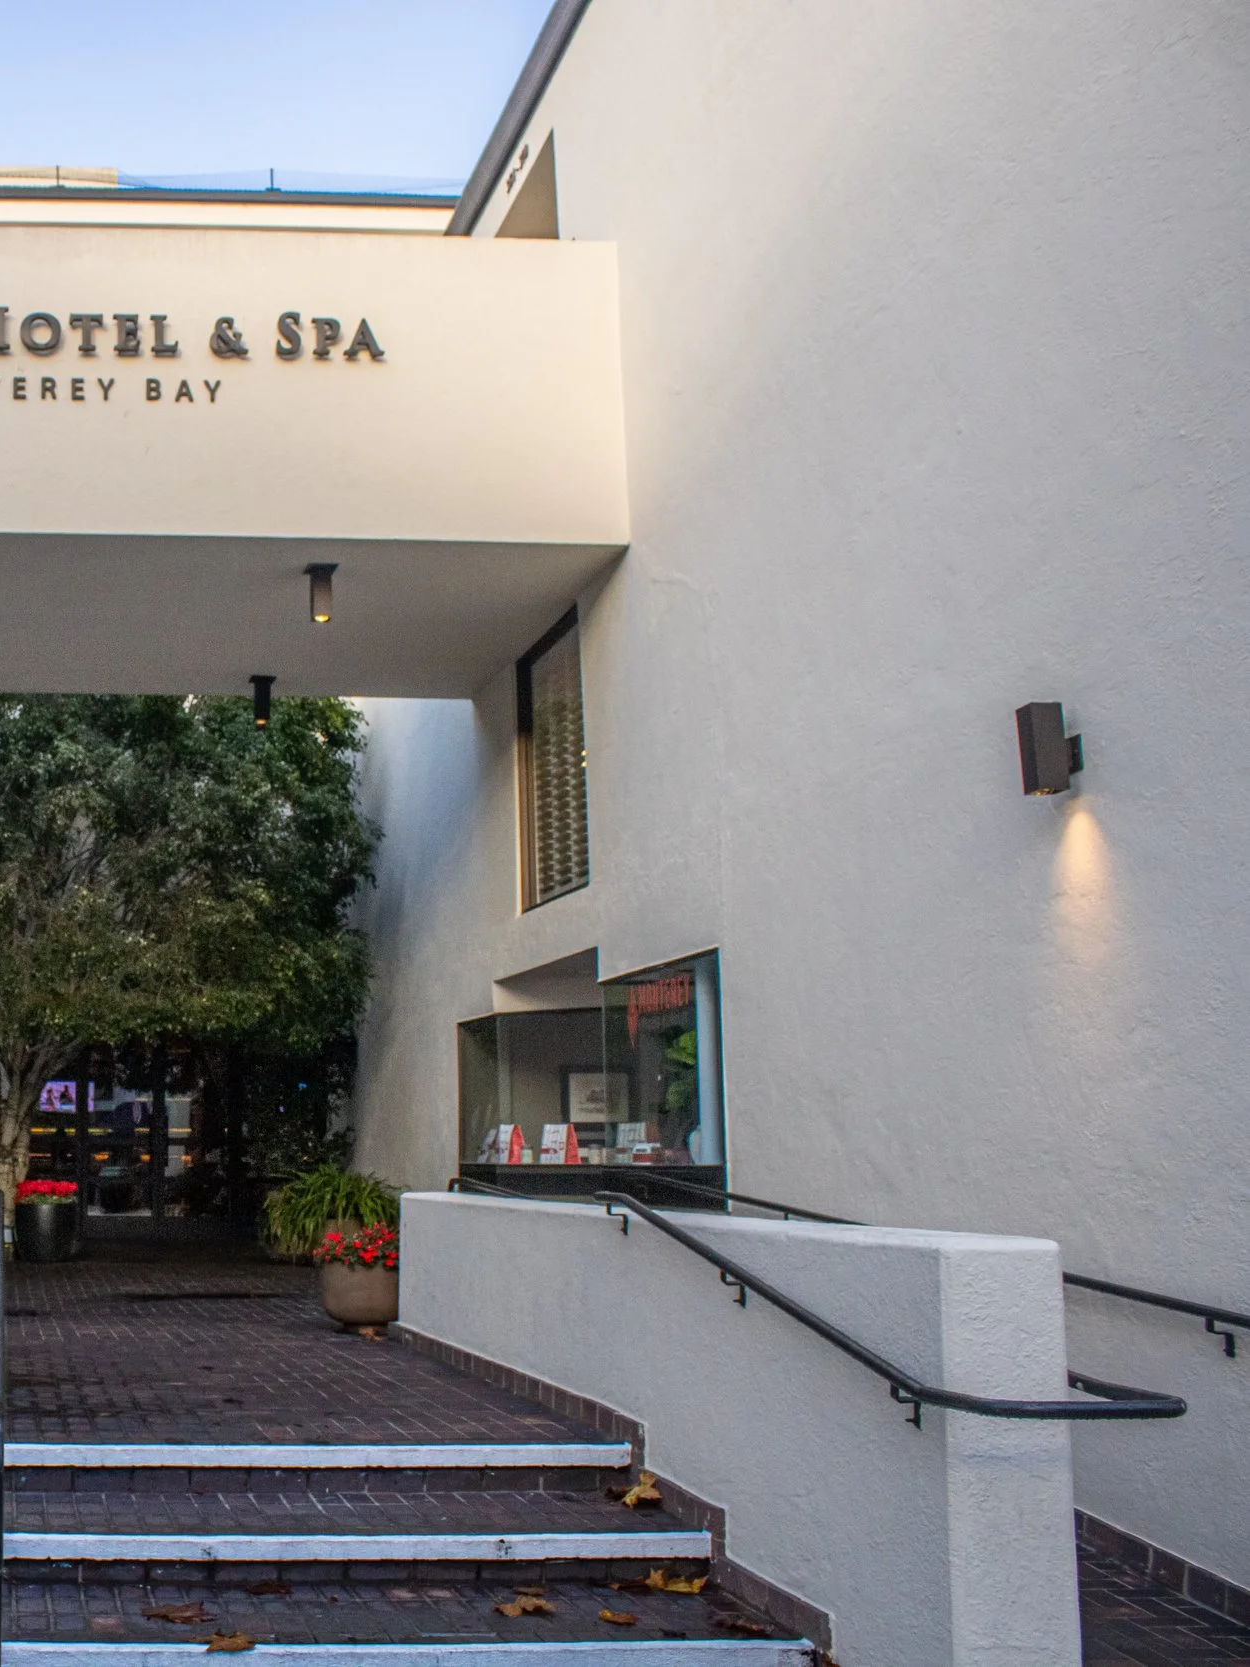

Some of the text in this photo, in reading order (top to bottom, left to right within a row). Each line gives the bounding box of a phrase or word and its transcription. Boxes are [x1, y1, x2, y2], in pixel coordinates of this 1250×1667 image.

[209, 317, 249, 361] &
[276, 312, 386, 363] SPA
[146, 377, 223, 404] BAY
